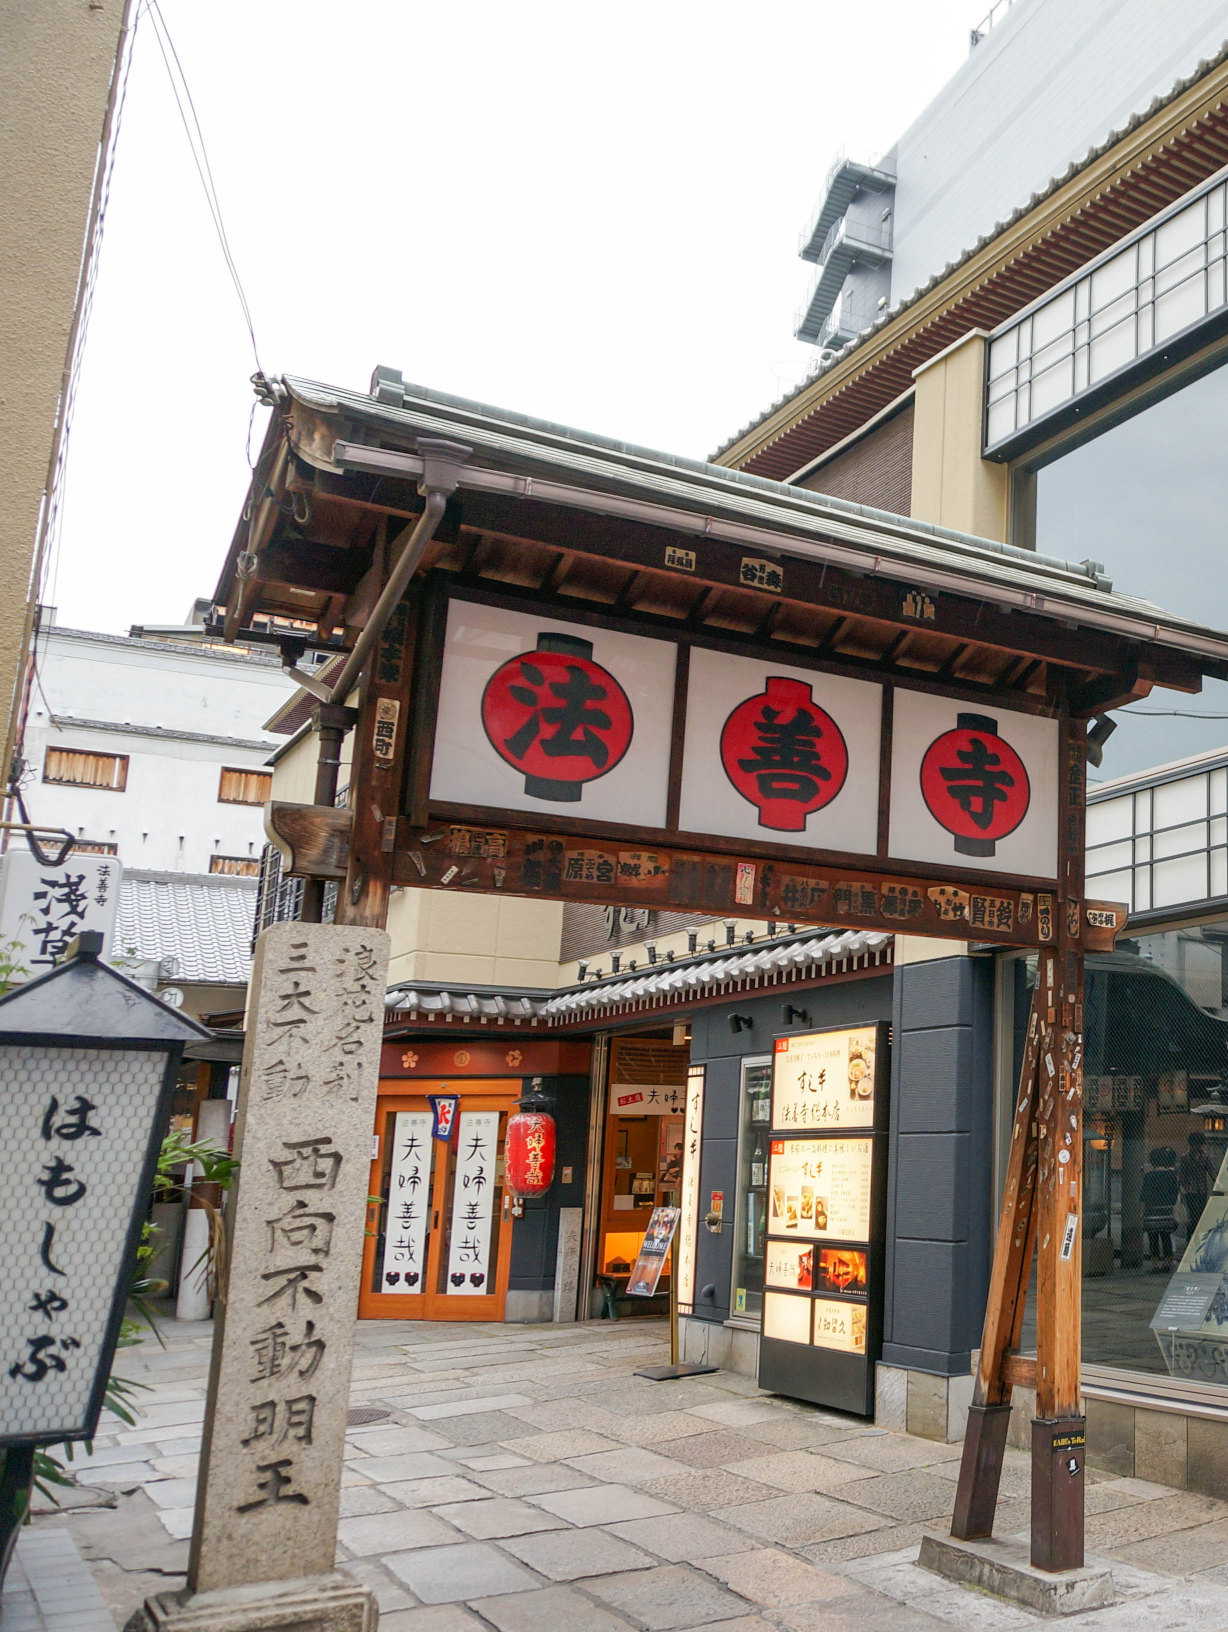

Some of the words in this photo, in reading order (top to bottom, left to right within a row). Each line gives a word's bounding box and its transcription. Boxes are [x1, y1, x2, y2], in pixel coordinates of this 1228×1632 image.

[94, 864, 112, 907] 法善寺
[260, 941, 322, 1102] 三大不動
[690, 1092, 700, 1158] すし半
[798, 1068, 826, 1094] すし半
[392, 1130, 423, 1265] 夫婦善哉
[458, 1130, 489, 1266] 夫婦善哉
[525, 1116, 546, 1186] 夫婦善哉
[801, 1161, 823, 1179] すし半
[9, 1095, 104, 1384] はもしゃぶ
[236, 1134, 344, 1516] 西向不動明王
